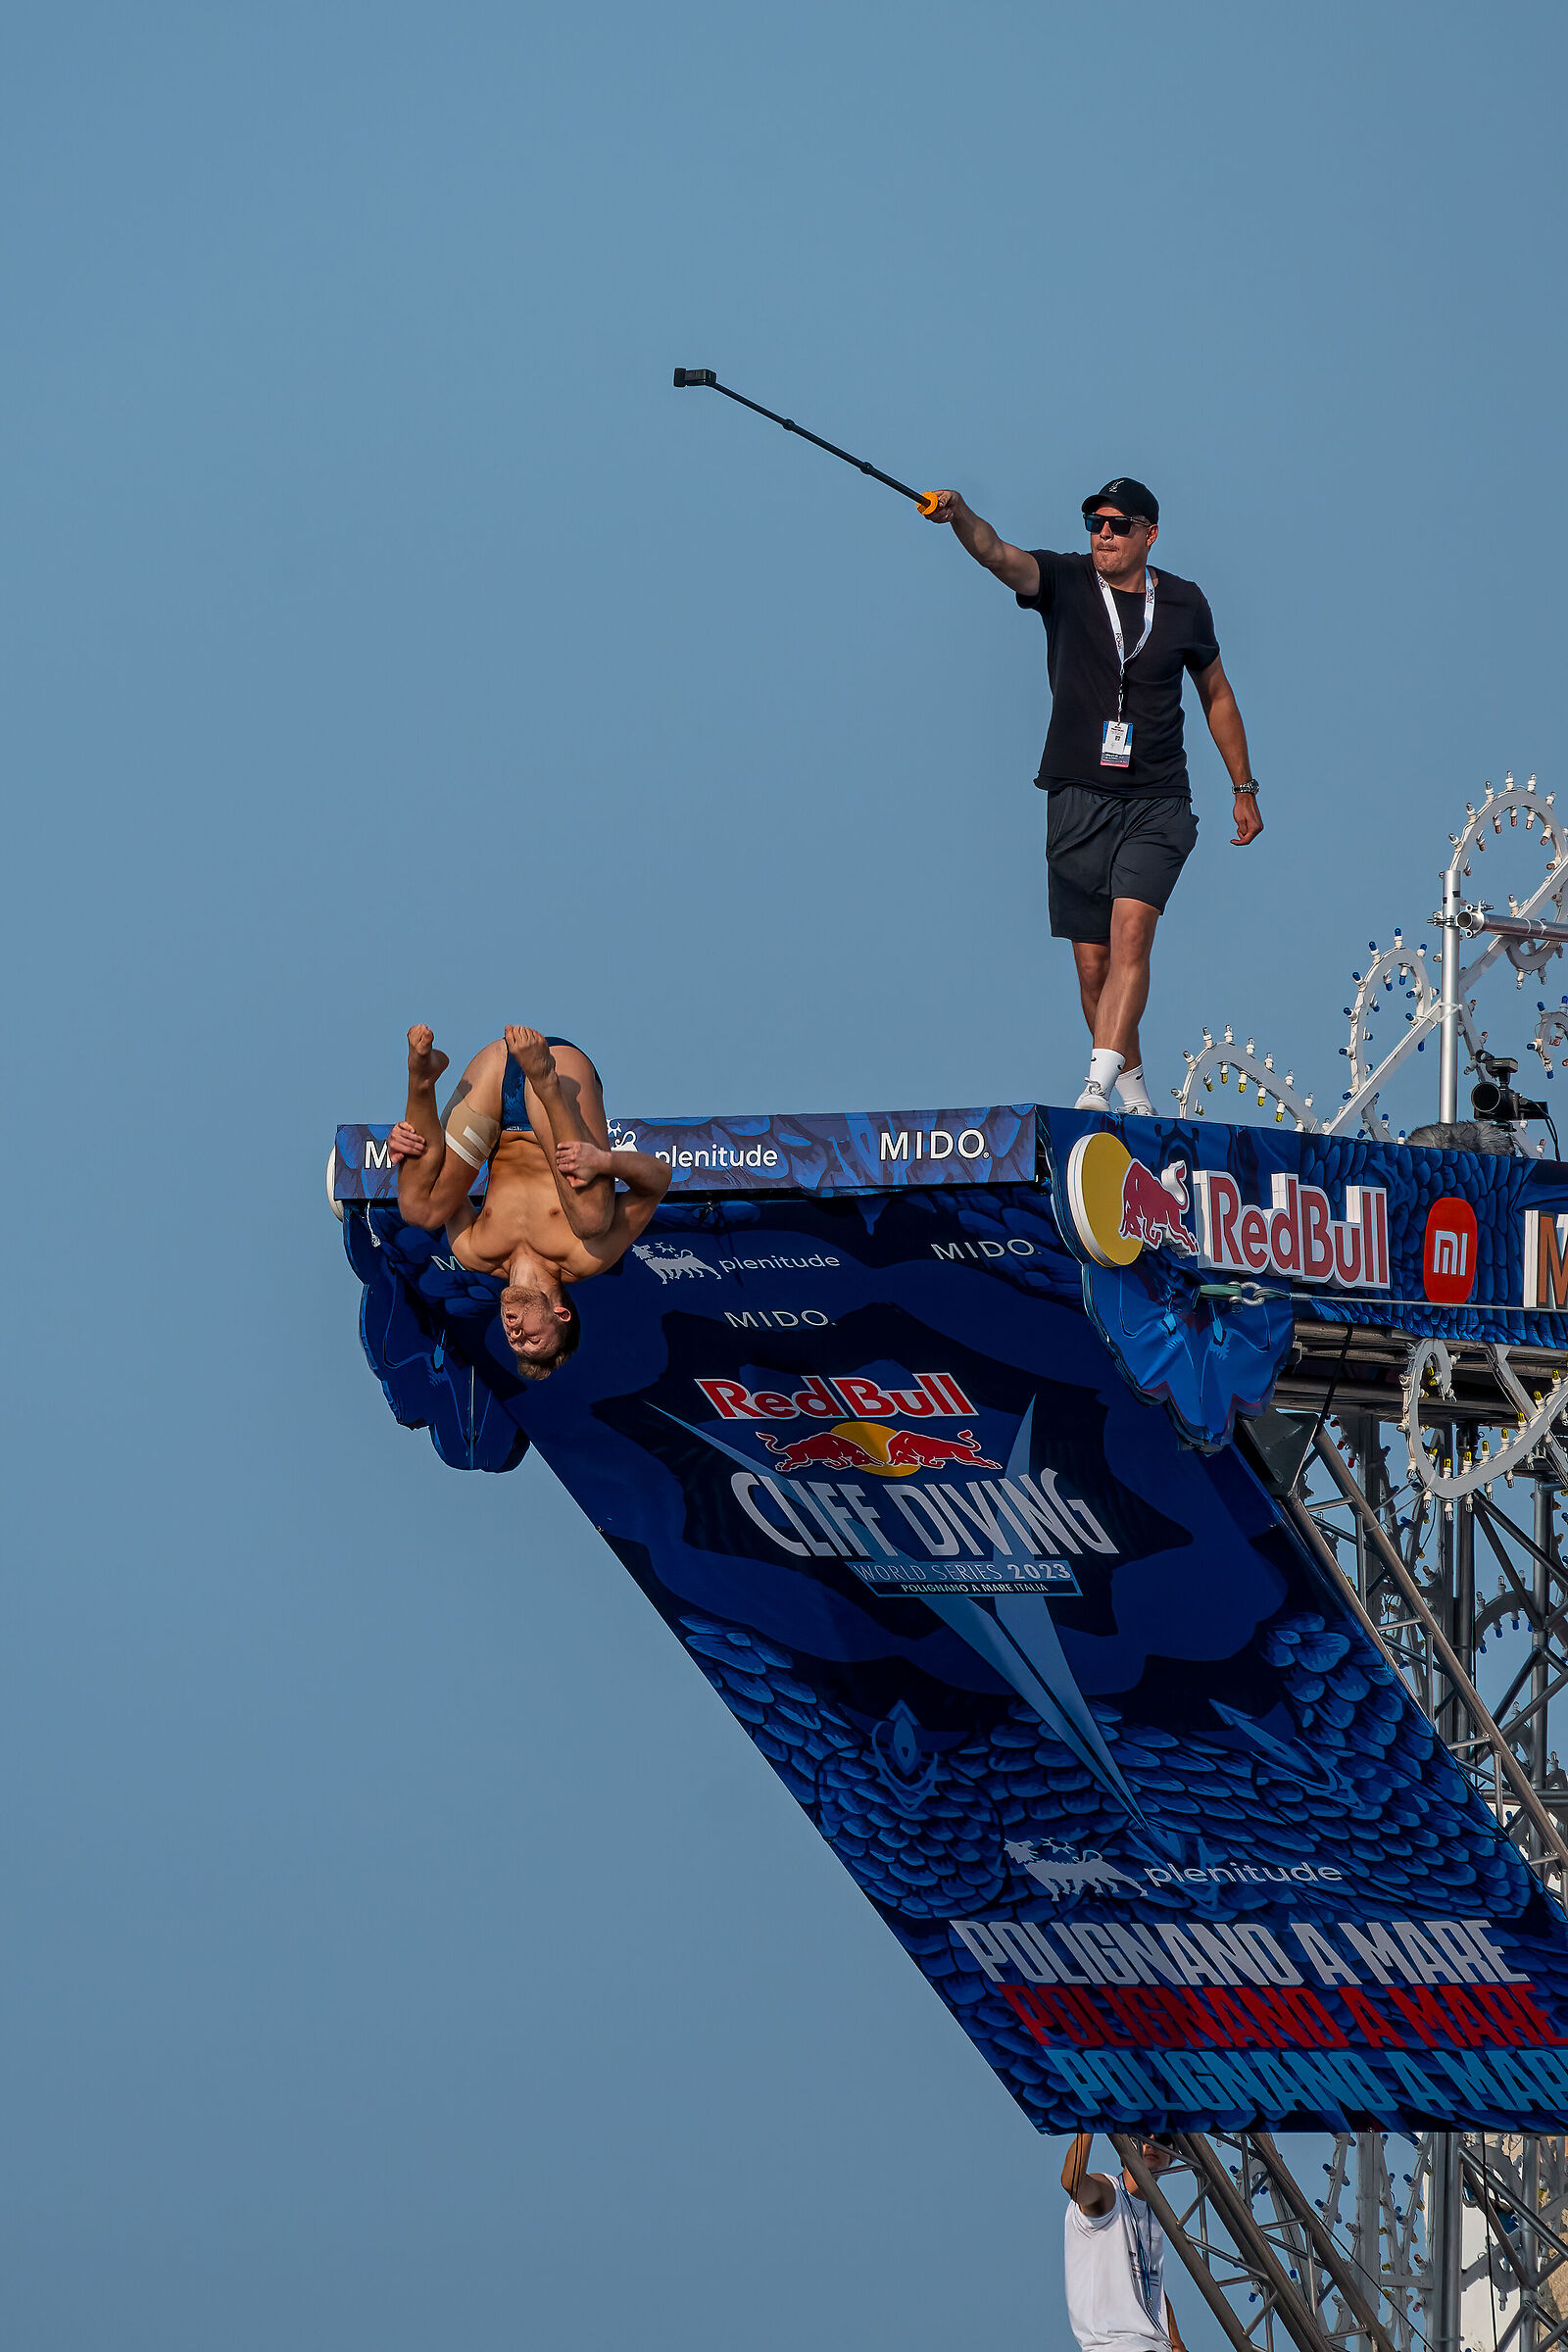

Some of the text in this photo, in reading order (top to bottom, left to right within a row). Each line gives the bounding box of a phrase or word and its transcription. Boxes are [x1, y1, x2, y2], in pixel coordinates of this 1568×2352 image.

[718, 1253, 840, 1273] plenitude
[730, 1468, 1119, 1556] CLIFF DIVING
[853, 1563, 1072, 1581] WORLD SERIES 2023
[901, 1584, 969, 1592] POLIGNANO
[1014, 1583, 1049, 1592] ITALIA
[1144, 1861, 1343, 1887] plenitude
[949, 1920, 1530, 1985] POLIGNANO A MARE
[997, 1984, 1568, 2048] POLIGNANO A MARE
[1043, 2049, 1568, 2111] POLIGNANO A MAR
